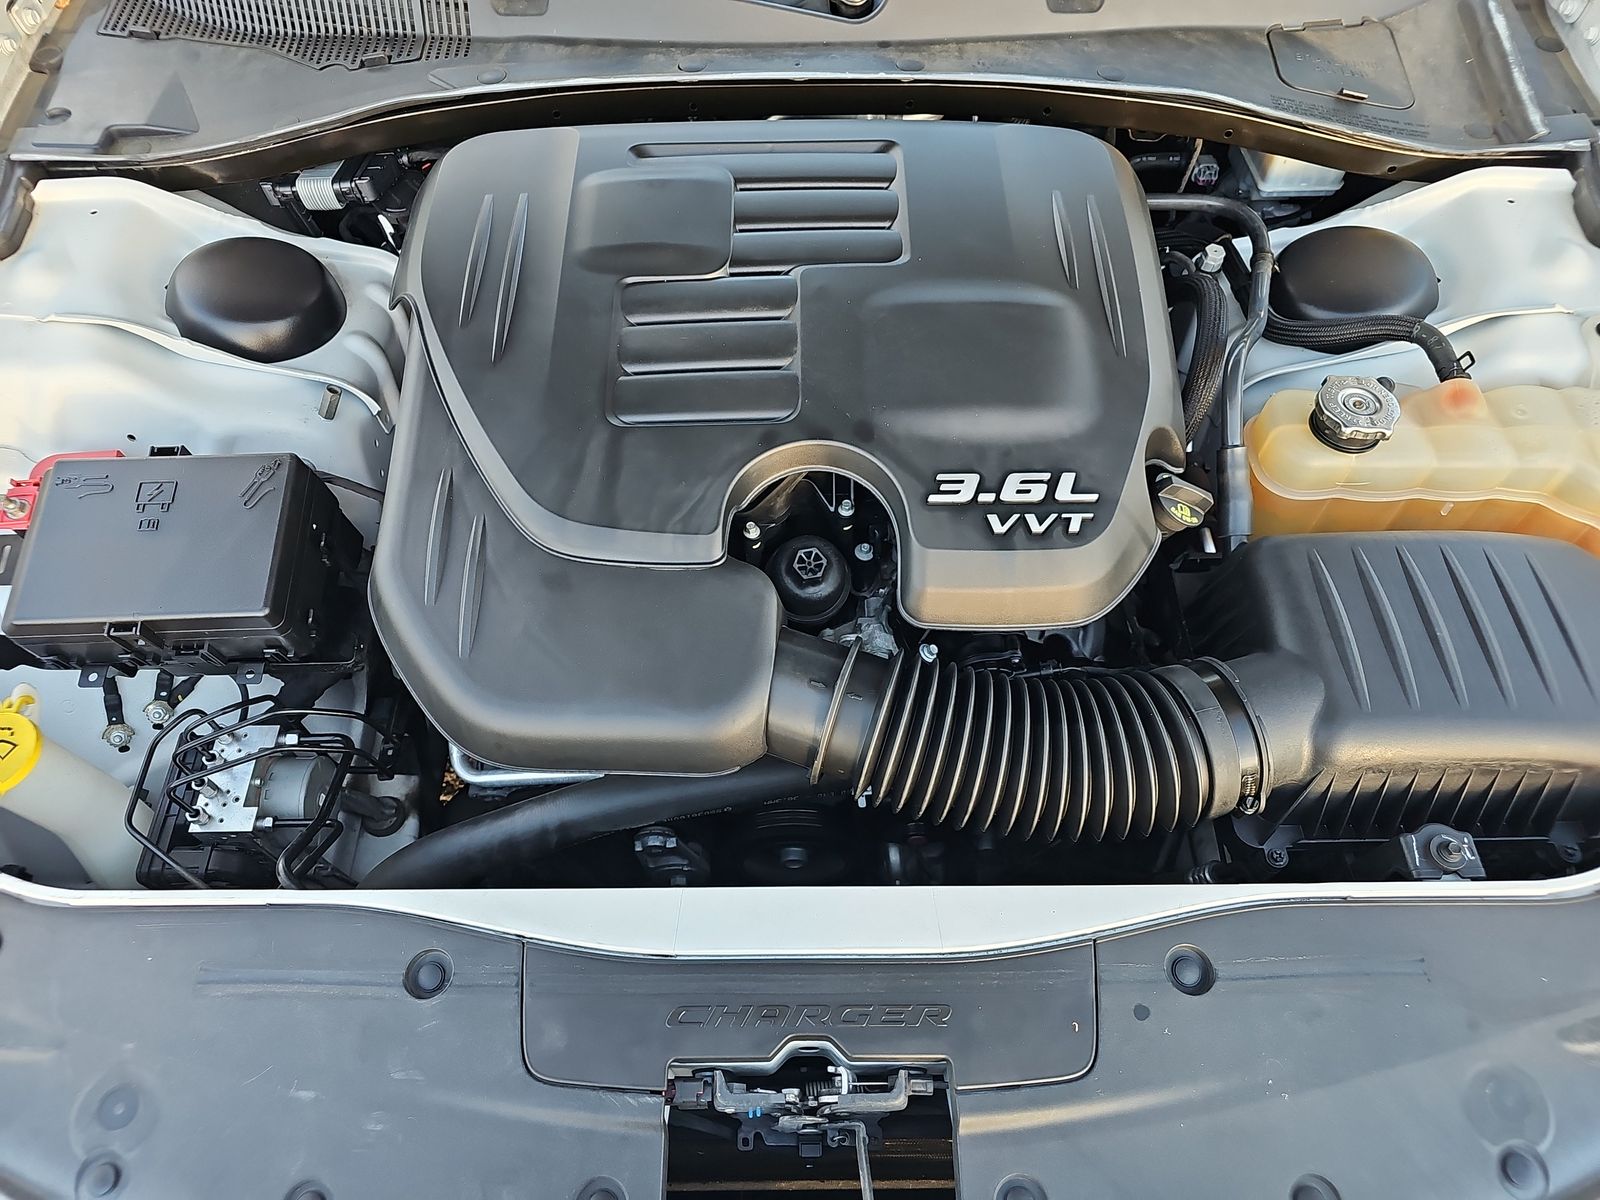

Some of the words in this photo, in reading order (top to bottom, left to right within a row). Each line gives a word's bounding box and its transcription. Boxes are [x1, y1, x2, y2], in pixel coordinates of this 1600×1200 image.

[927, 472, 1100, 505] 3.6L
[985, 513, 1095, 535] VVT
[665, 1004, 952, 1028] CHARGER
